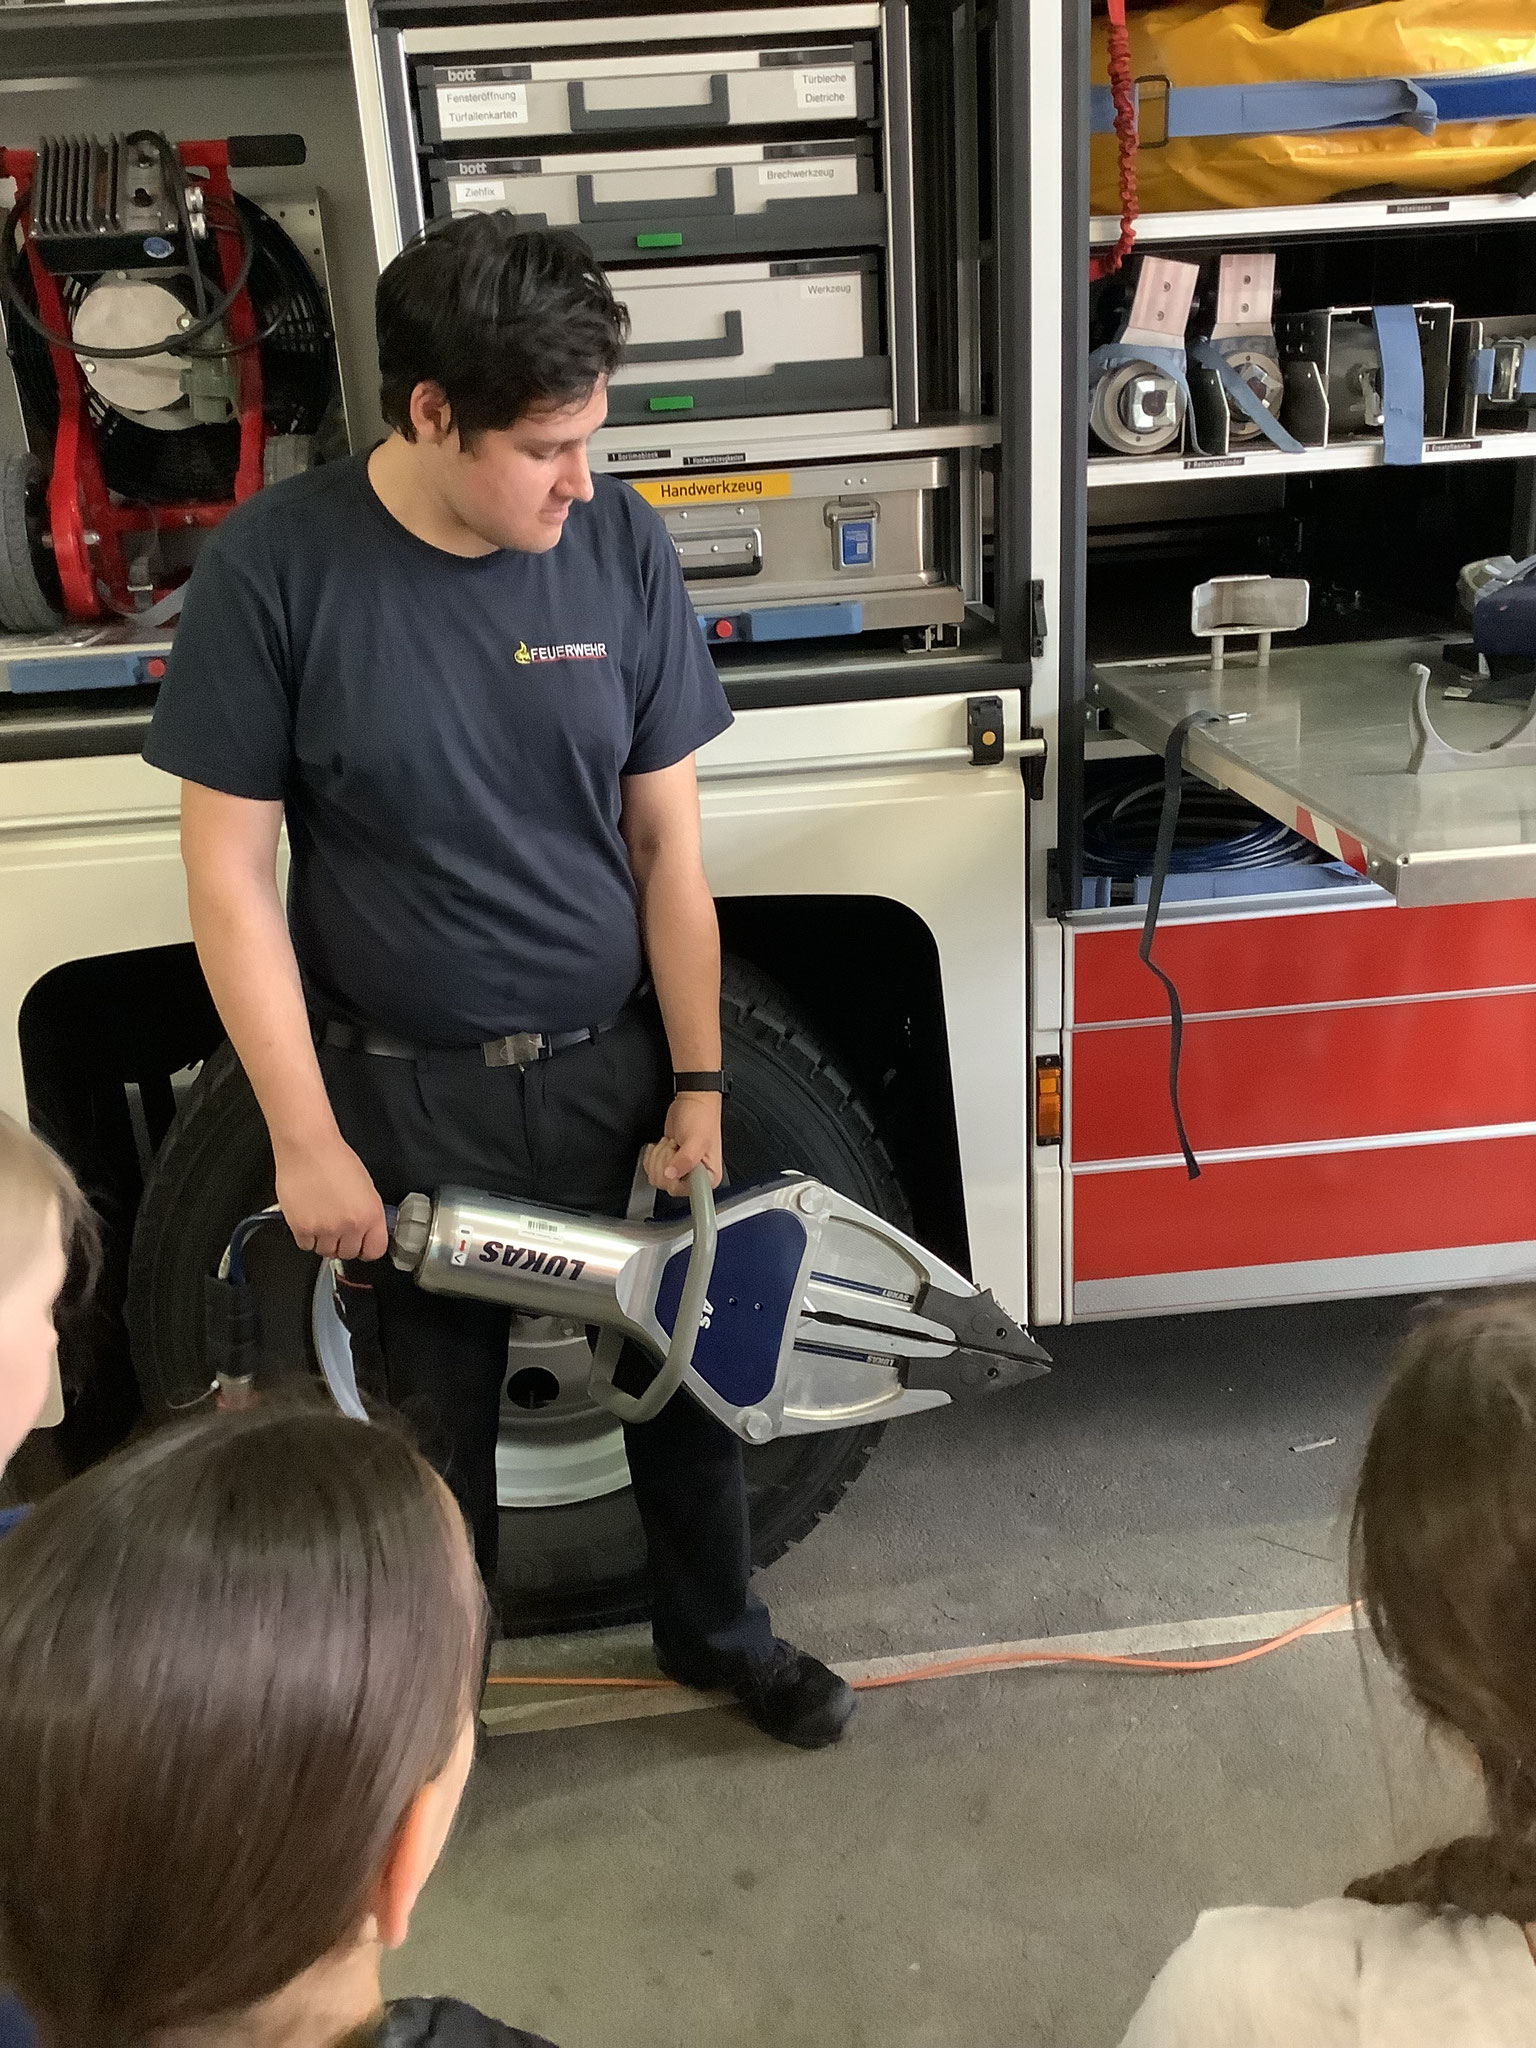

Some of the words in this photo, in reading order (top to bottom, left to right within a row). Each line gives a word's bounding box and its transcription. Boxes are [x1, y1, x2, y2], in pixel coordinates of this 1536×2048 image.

[447, 69, 476, 81] bott
[802, 73, 847, 84] Türbleche
[446, 91, 516, 103] Fensteröffnung
[805, 92, 845, 103] Dietriche
[449, 110, 518, 122] Türfallenkarten
[459, 162, 487, 175] bott
[766, 168, 834, 179] Brechwerkzeug
[465, 187, 495, 198] Ziehfix
[807, 284, 851, 295] Werkzeug
[660, 479, 763, 498] Handwerkzeug
[530, 642, 608, 661] FEUERWEHR
[478, 1240, 587, 1281] LUKAS
[882, 1289, 910, 1302] LUKAS
[866, 1355, 895, 1367] LUKAS
